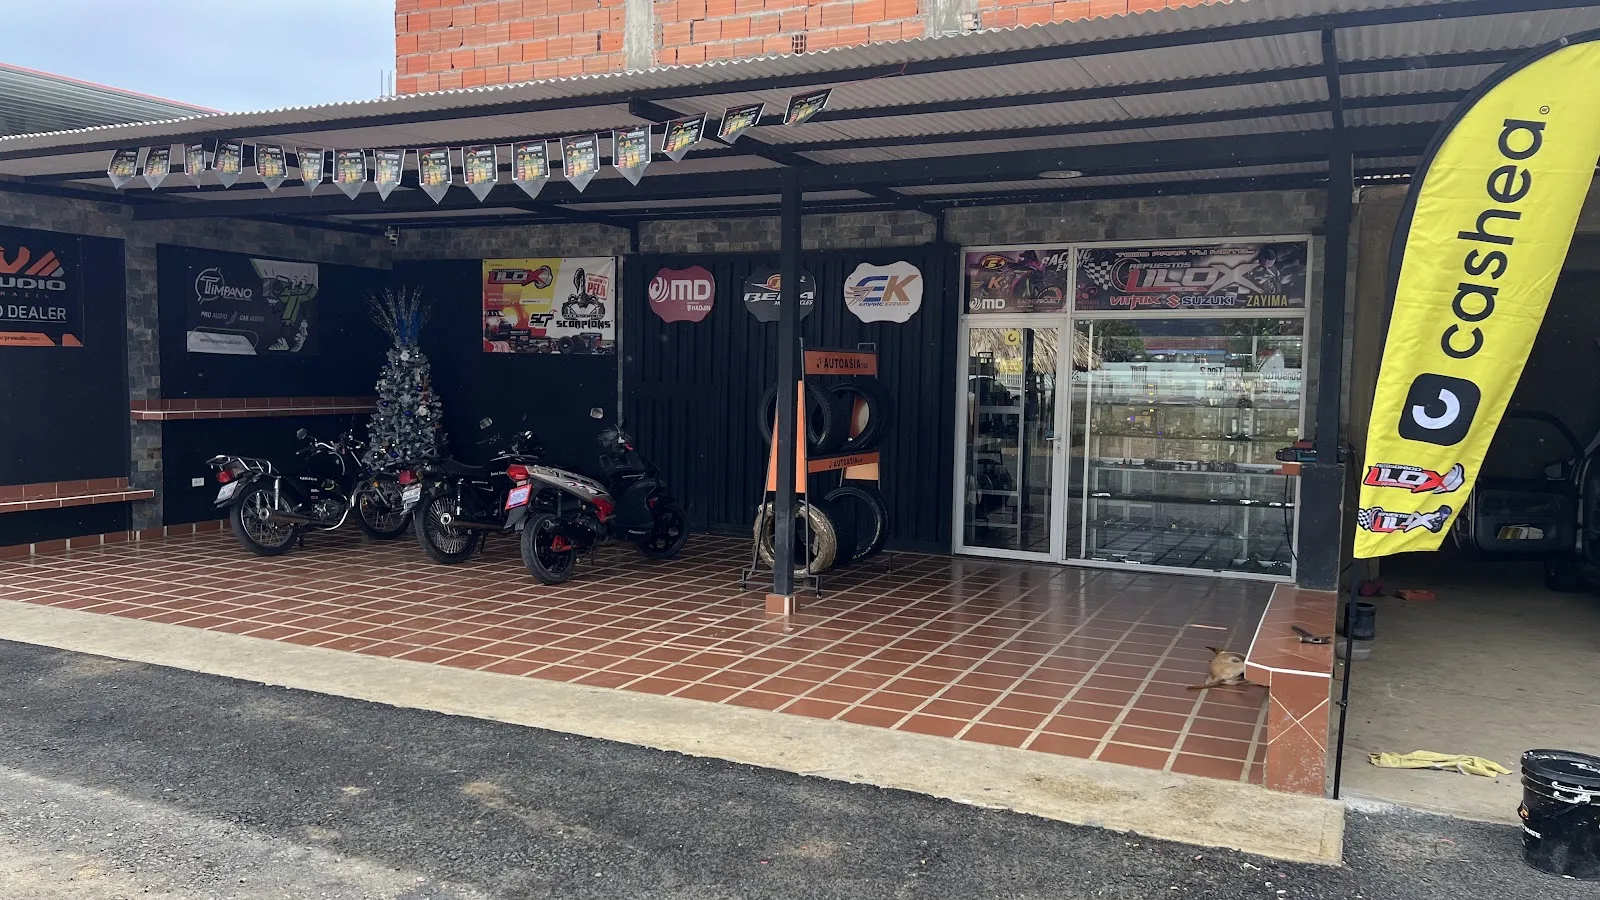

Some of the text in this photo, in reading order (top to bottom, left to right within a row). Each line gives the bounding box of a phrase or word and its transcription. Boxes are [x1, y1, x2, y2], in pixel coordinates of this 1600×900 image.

[1441, 118, 1546, 359] cashea
[0, 276, 66, 291] UDIO
[671, 280, 711, 300] MD
[743, 292, 814, 302] BEA
[1183, 295, 1235, 306] SUZUKI
[1246, 294, 1288, 307] ZAYIMA
[982, 299, 1006, 309] MD
[7, 304, 67, 320] DEALER
[823, 357, 861, 369] AUTOASIA
